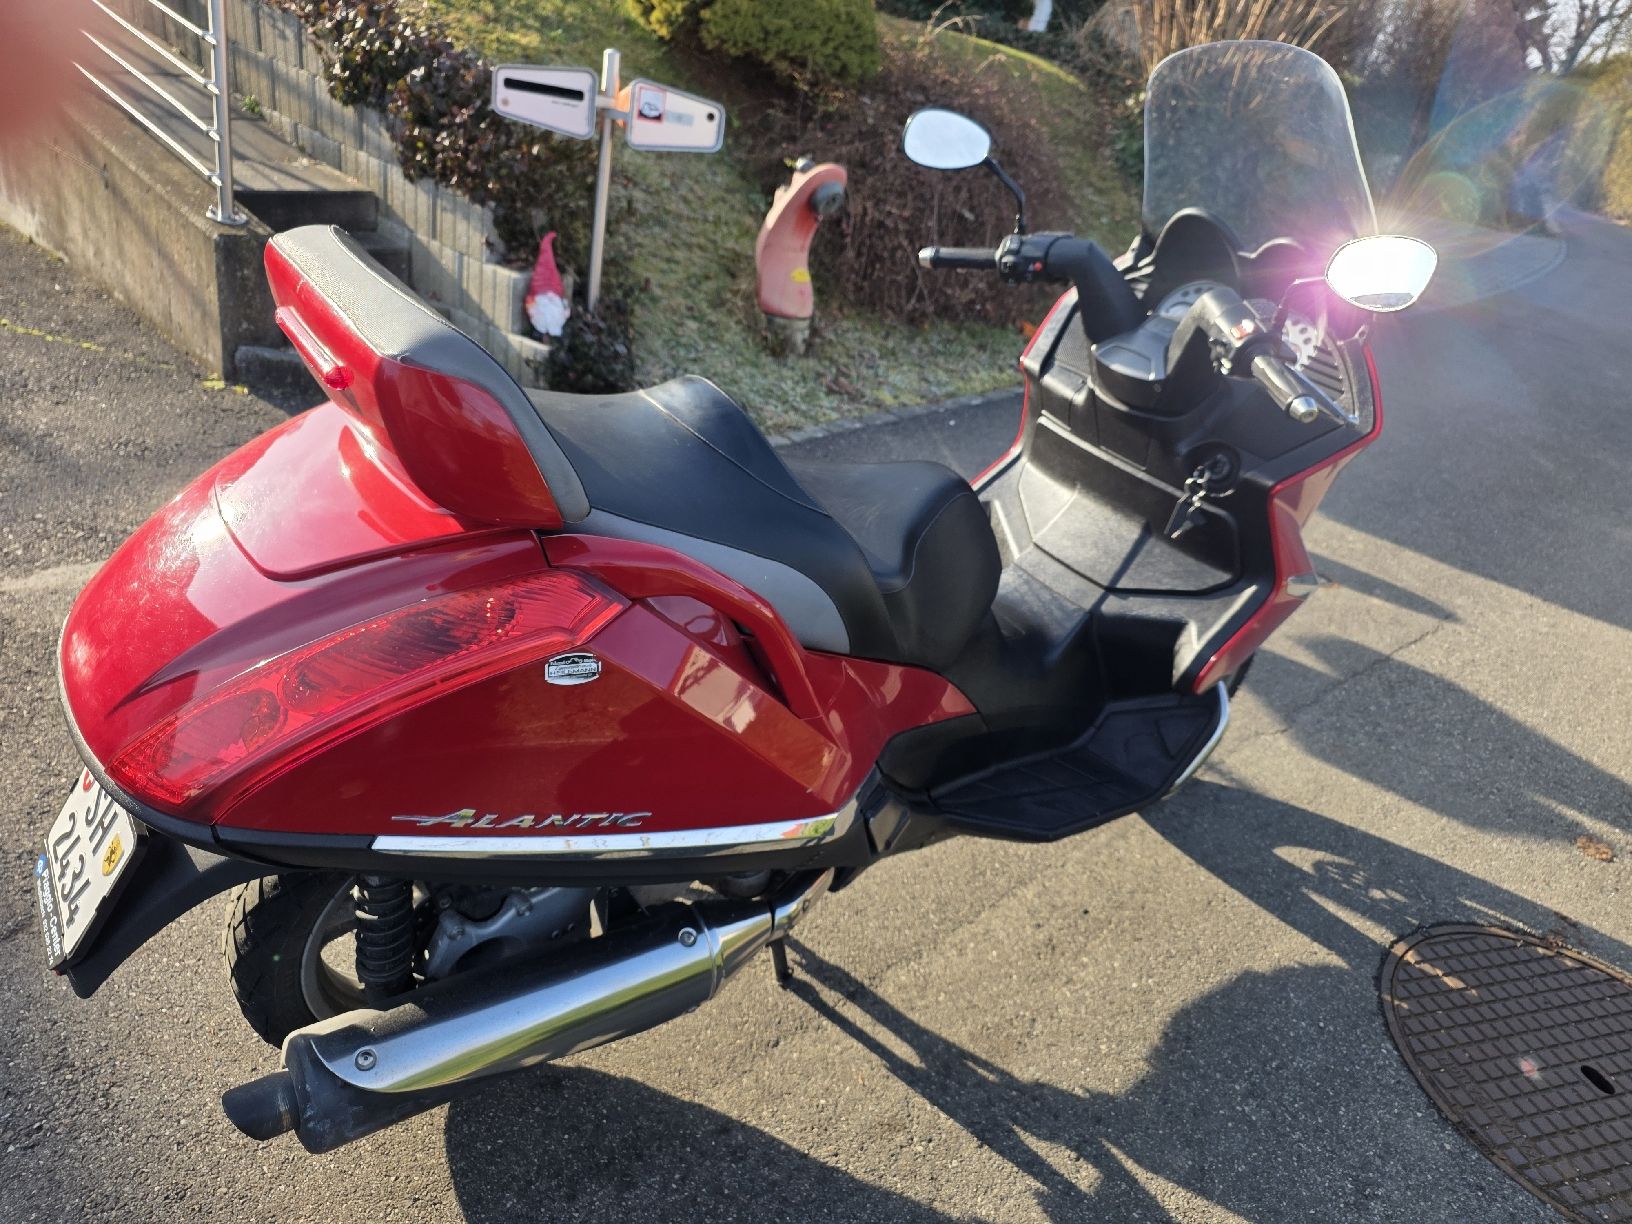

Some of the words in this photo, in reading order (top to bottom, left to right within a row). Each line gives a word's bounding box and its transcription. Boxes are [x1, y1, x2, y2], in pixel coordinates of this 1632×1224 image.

[85, 788, 118, 856] SH
[392, 808, 652, 829] ALANTIC
[52, 811, 91, 929] 2434
